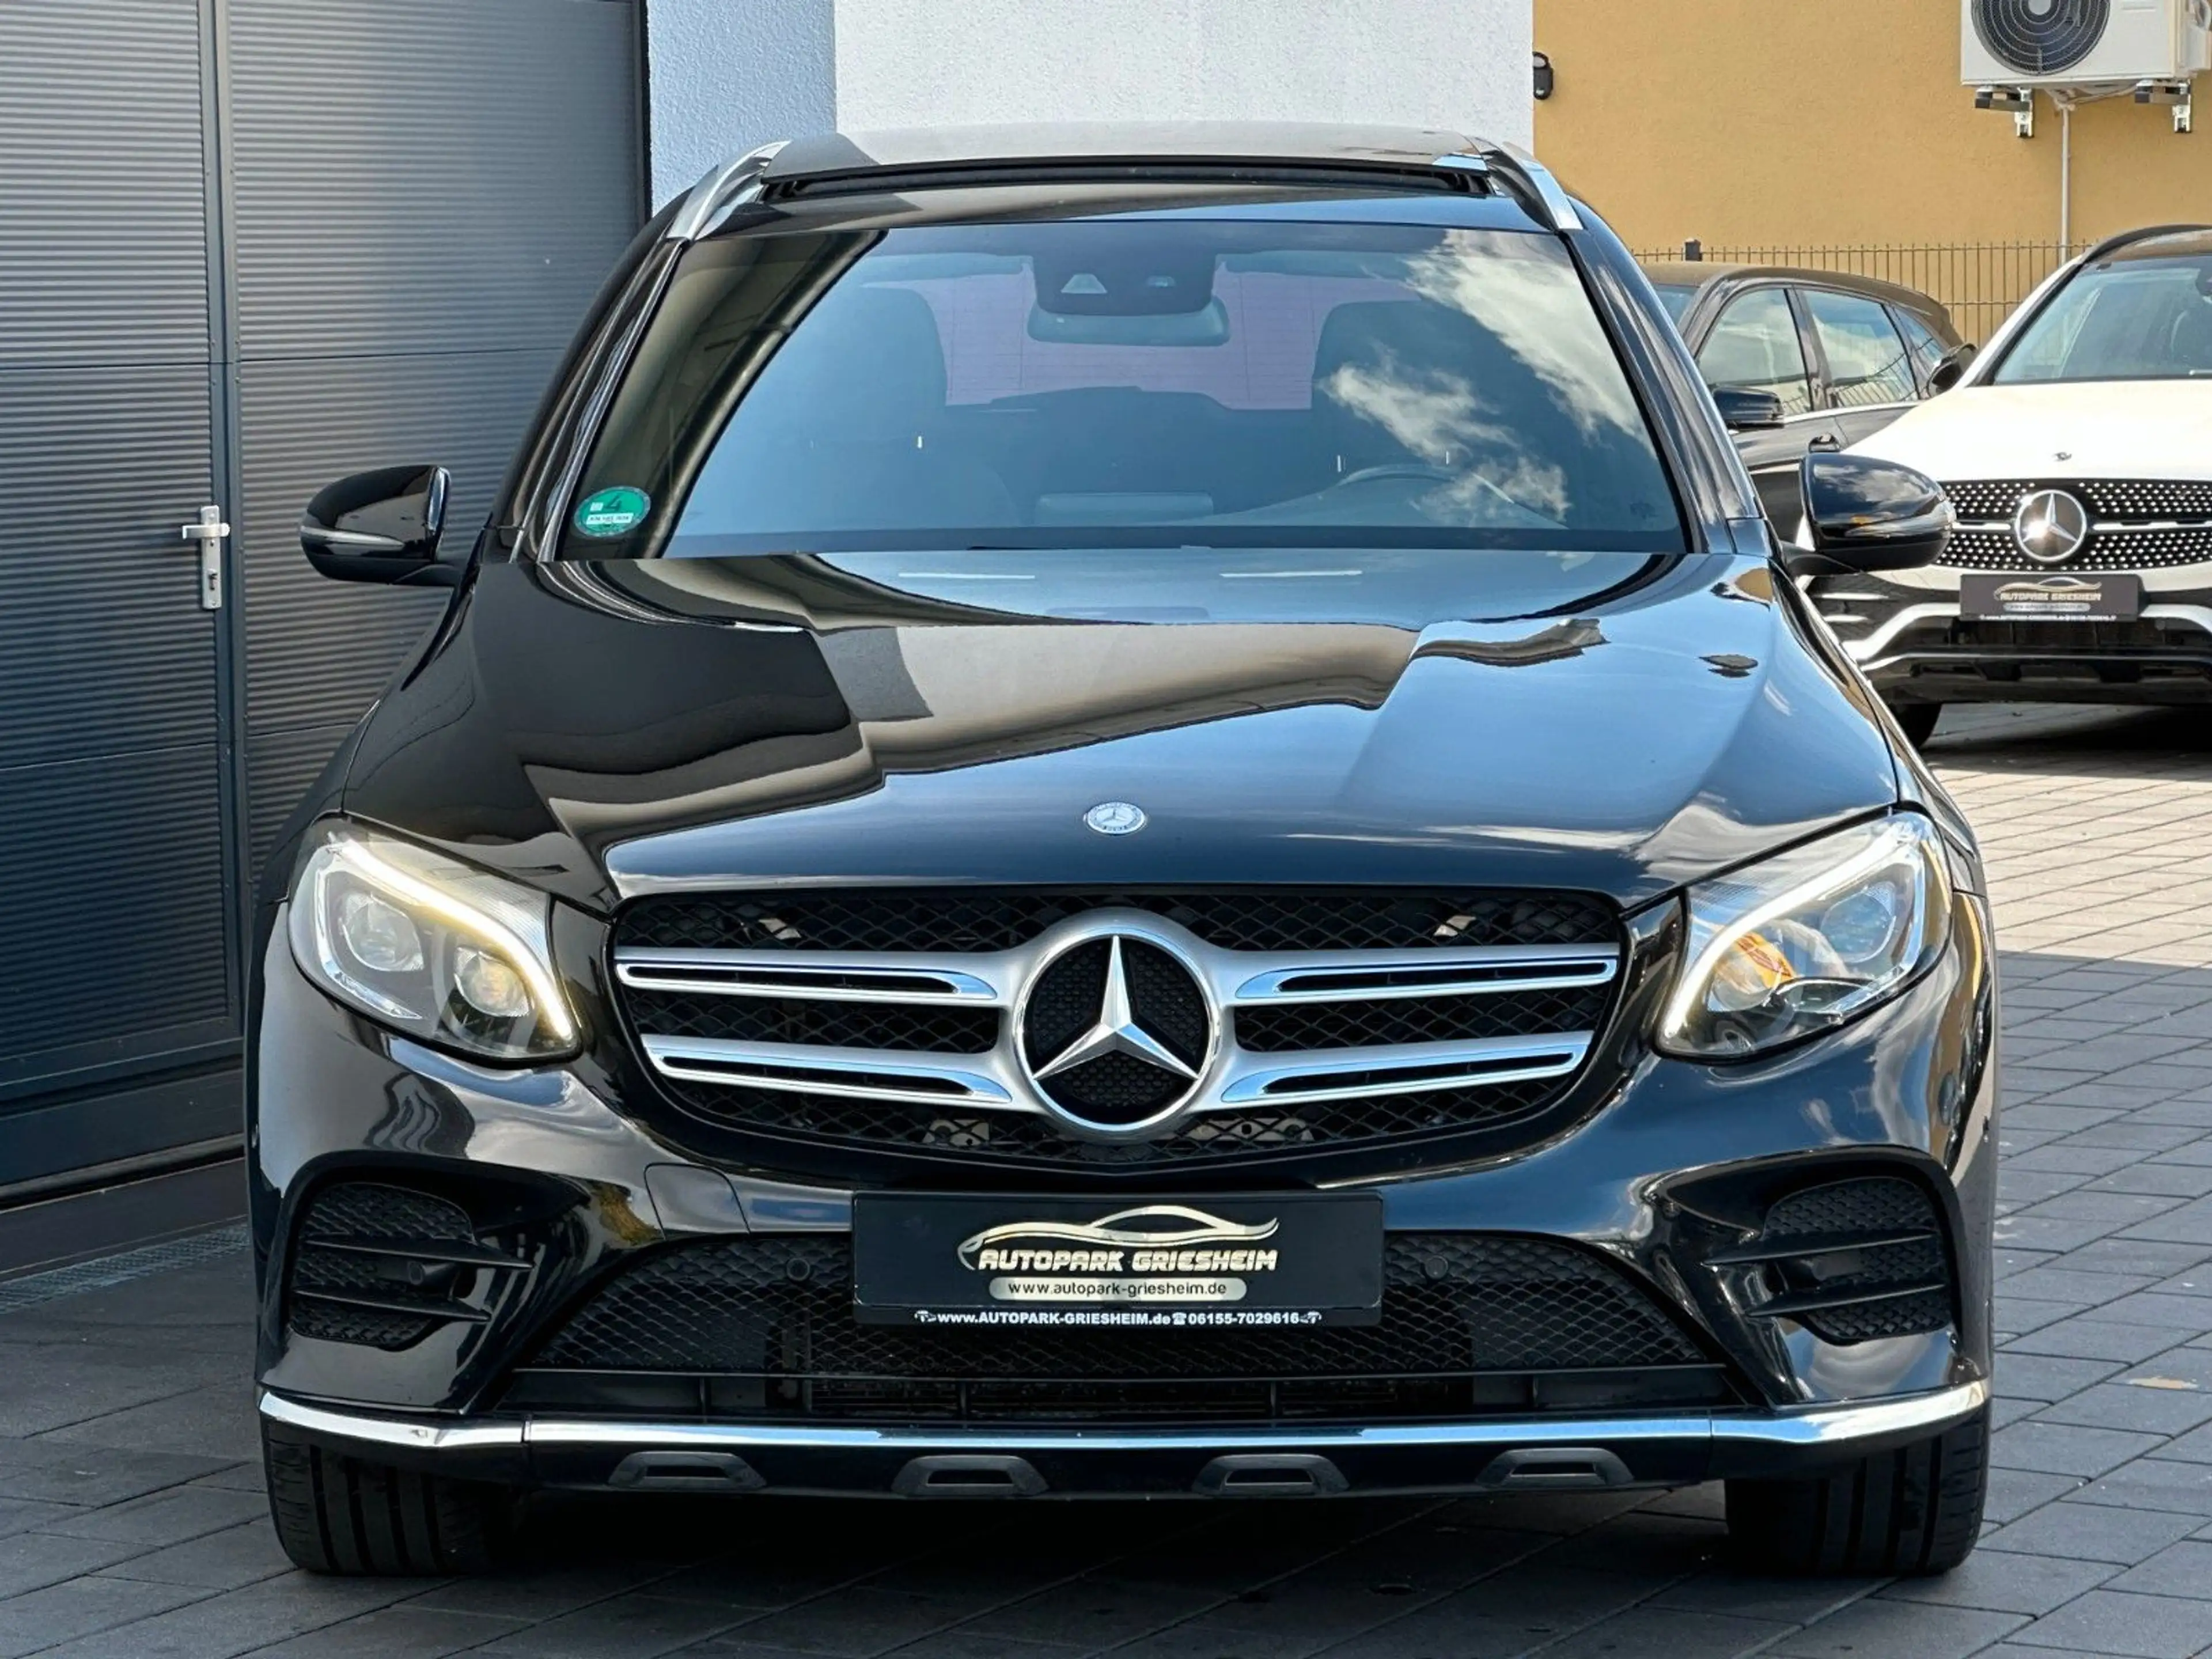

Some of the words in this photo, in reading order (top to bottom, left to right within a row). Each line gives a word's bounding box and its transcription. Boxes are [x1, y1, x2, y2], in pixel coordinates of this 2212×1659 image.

[603, 493, 623, 512] 4
[978, 1249, 1124, 1272] AUTOPARK
[1131, 1249, 1278, 1272] GRIESHEIM
[1008, 1281, 1227, 1298] www.autopark-griesheim.de
[937, 1311, 1171, 1325] www.AUTOPARK-GRIESHEIM.de
[1188, 1312, 1300, 1325] 06155-7029616
